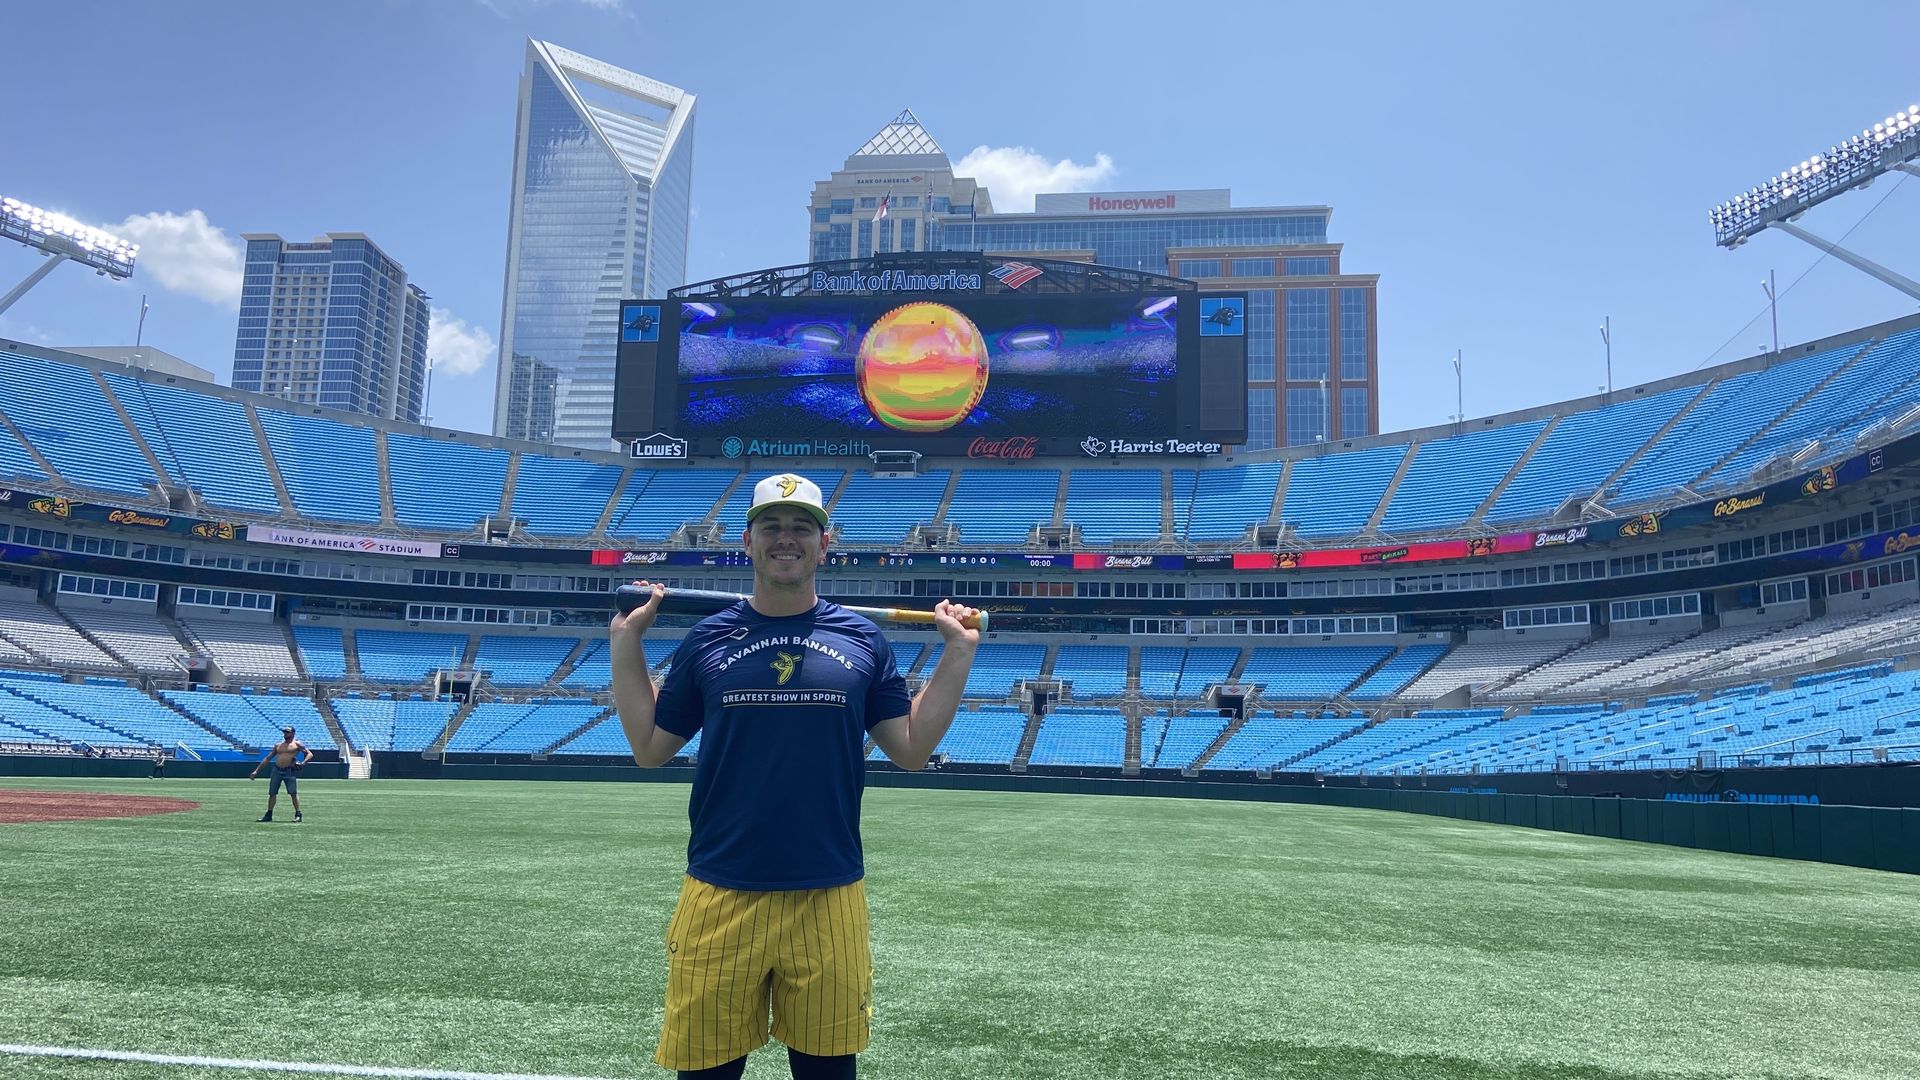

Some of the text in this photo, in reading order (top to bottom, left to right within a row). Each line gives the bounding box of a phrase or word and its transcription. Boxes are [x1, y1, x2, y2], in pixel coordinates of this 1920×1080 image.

[857, 178, 873, 186] BANK
[1088, 195, 1176, 211] Honeywell
[811, 268, 982, 292] Bank of America
[636, 442, 682, 456] LOWE'S
[746, 439, 871, 456] Atrium Health
[1109, 440, 1221, 454] Harris Teeter
[1871, 455, 1881, 467] CC
[1713, 491, 1766, 517] Go Bananas!
[108, 510, 170, 528] Go Bananas!
[272, 533, 355, 549] ANK OF AMERICA
[1535, 527, 1588, 547] Banana Ball
[379, 544, 423, 555] STADIUM
[446, 547, 458, 555] CC
[960, 556, 967, 564] S
[1030, 559, 1051, 567] 00:00
[1105, 555, 1154, 568] Banana Ball
[718, 636, 854, 673] SAVANNAH BANANAS
[722, 693, 847, 704] GREATEST SHOW IN SPORTS
